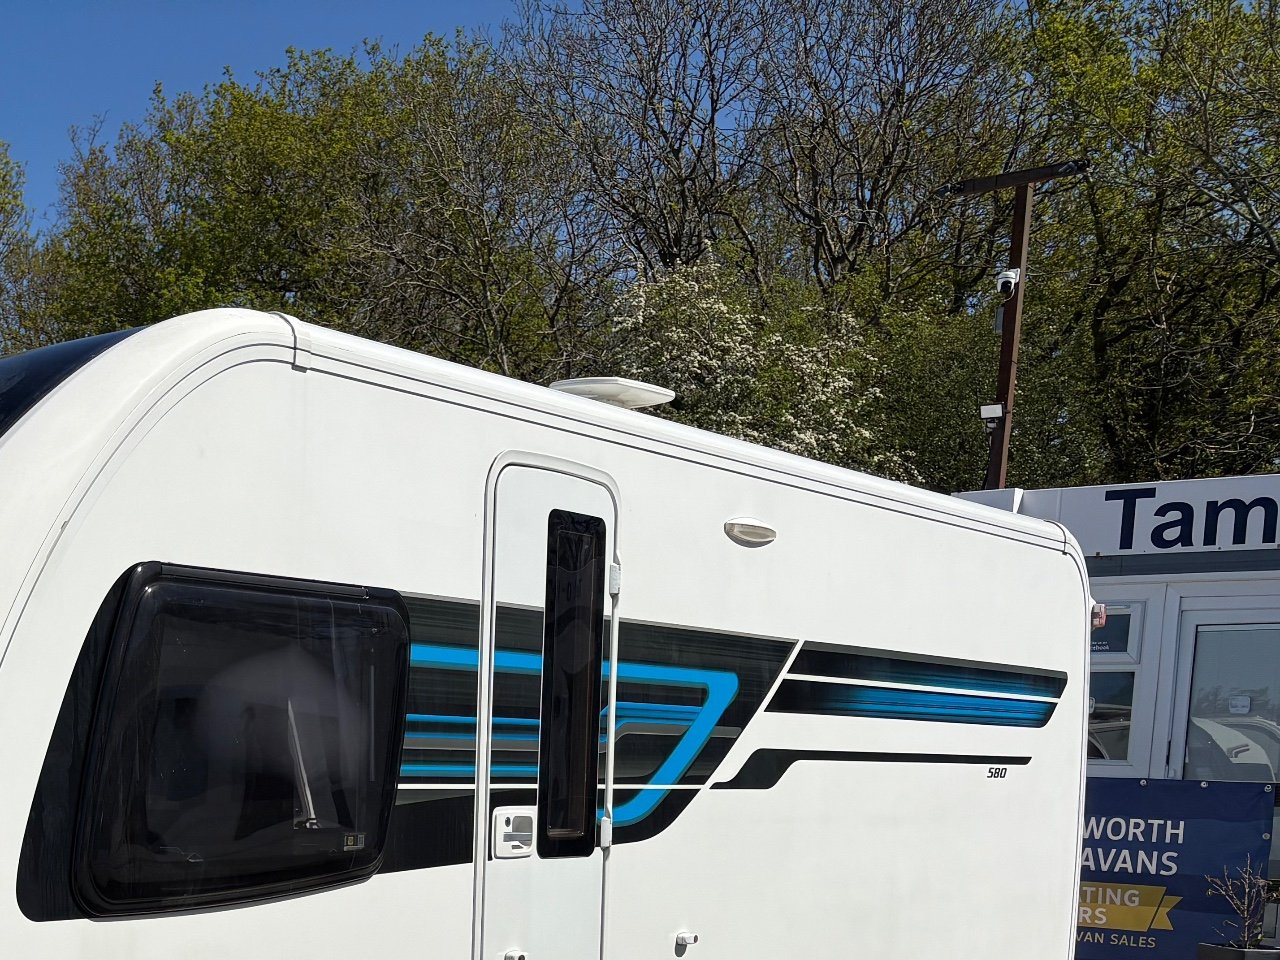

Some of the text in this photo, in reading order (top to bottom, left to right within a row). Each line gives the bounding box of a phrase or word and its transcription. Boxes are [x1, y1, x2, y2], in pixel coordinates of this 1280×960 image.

[1105, 487, 1280, 549] Tam
[986, 767, 1007, 779] 580
[1079, 886, 1140, 907] TING
[1110, 934, 1157, 948] SALES
